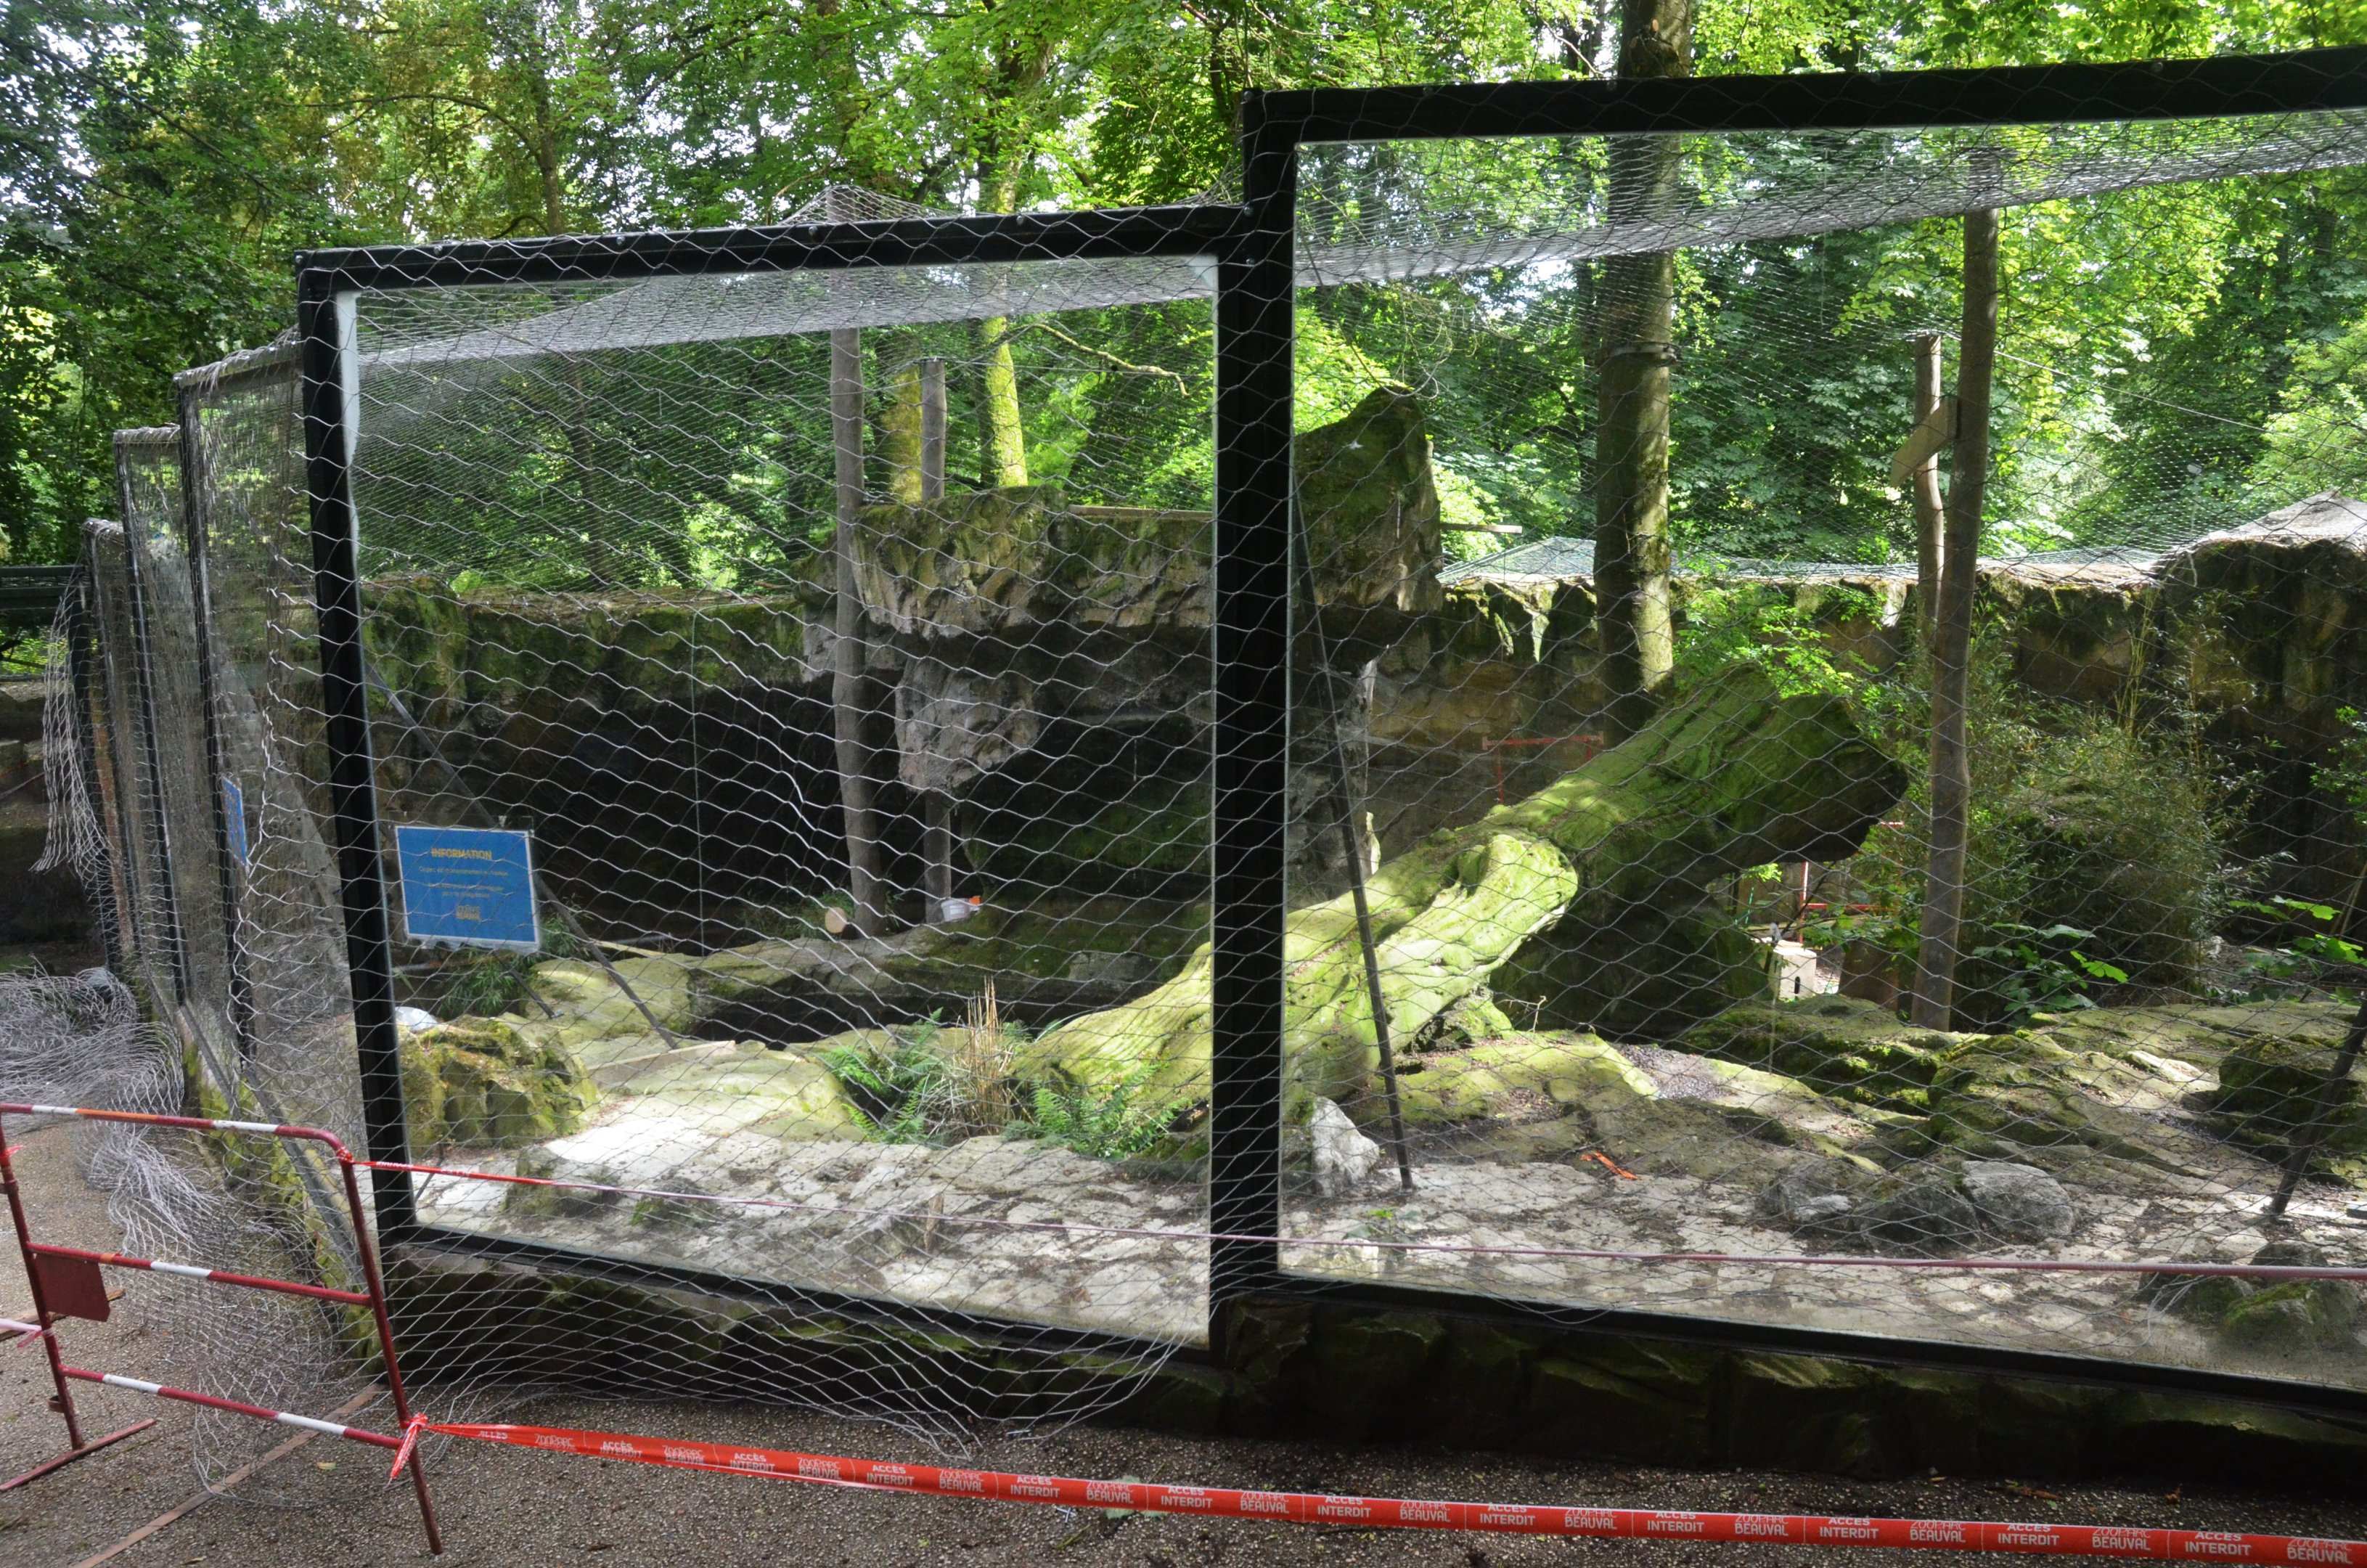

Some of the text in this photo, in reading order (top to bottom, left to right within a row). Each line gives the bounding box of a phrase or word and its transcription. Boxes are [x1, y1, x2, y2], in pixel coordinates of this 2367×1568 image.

[431, 849, 492, 859] INFORMATION
[729, 1459, 775, 1472] INTERDIT
[799, 1465, 841, 1479] BEAUVAL
[872, 1464, 906, 1474] ACCÈS
[867, 1472, 915, 1485] INTERDIT
[939, 1478, 985, 1493] BEAUVAL
[1010, 1485, 1060, 1498] INTERDIT
[1087, 1489, 1134, 1504] BEAUVAL
[1161, 1495, 1212, 1508] INTERDIT
[1240, 1500, 1289, 1514] BEAUVAL
[1317, 1505, 1371, 1519] INTERDIT
[1400, 1508, 1451, 1522] BEAUVAL
[1480, 1512, 1536, 1526] INTERDIT
[1564, 1516, 1617, 1530] BEAUVAL
[1647, 1520, 1705, 1533] INTERDIT
[1734, 1522, 1788, 1537] BEAUVAL
[1820, 1526, 1879, 1540] INTERDIT
[1910, 1529, 1966, 1543] BEAUVAL
[1998, 1532, 2059, 1546] INTERDIT
[2092, 1536, 2151, 1551] BEAUVAL
[2186, 1540, 2252, 1556] INTERDIT
[2287, 1547, 2352, 1564] BEAUVAL
